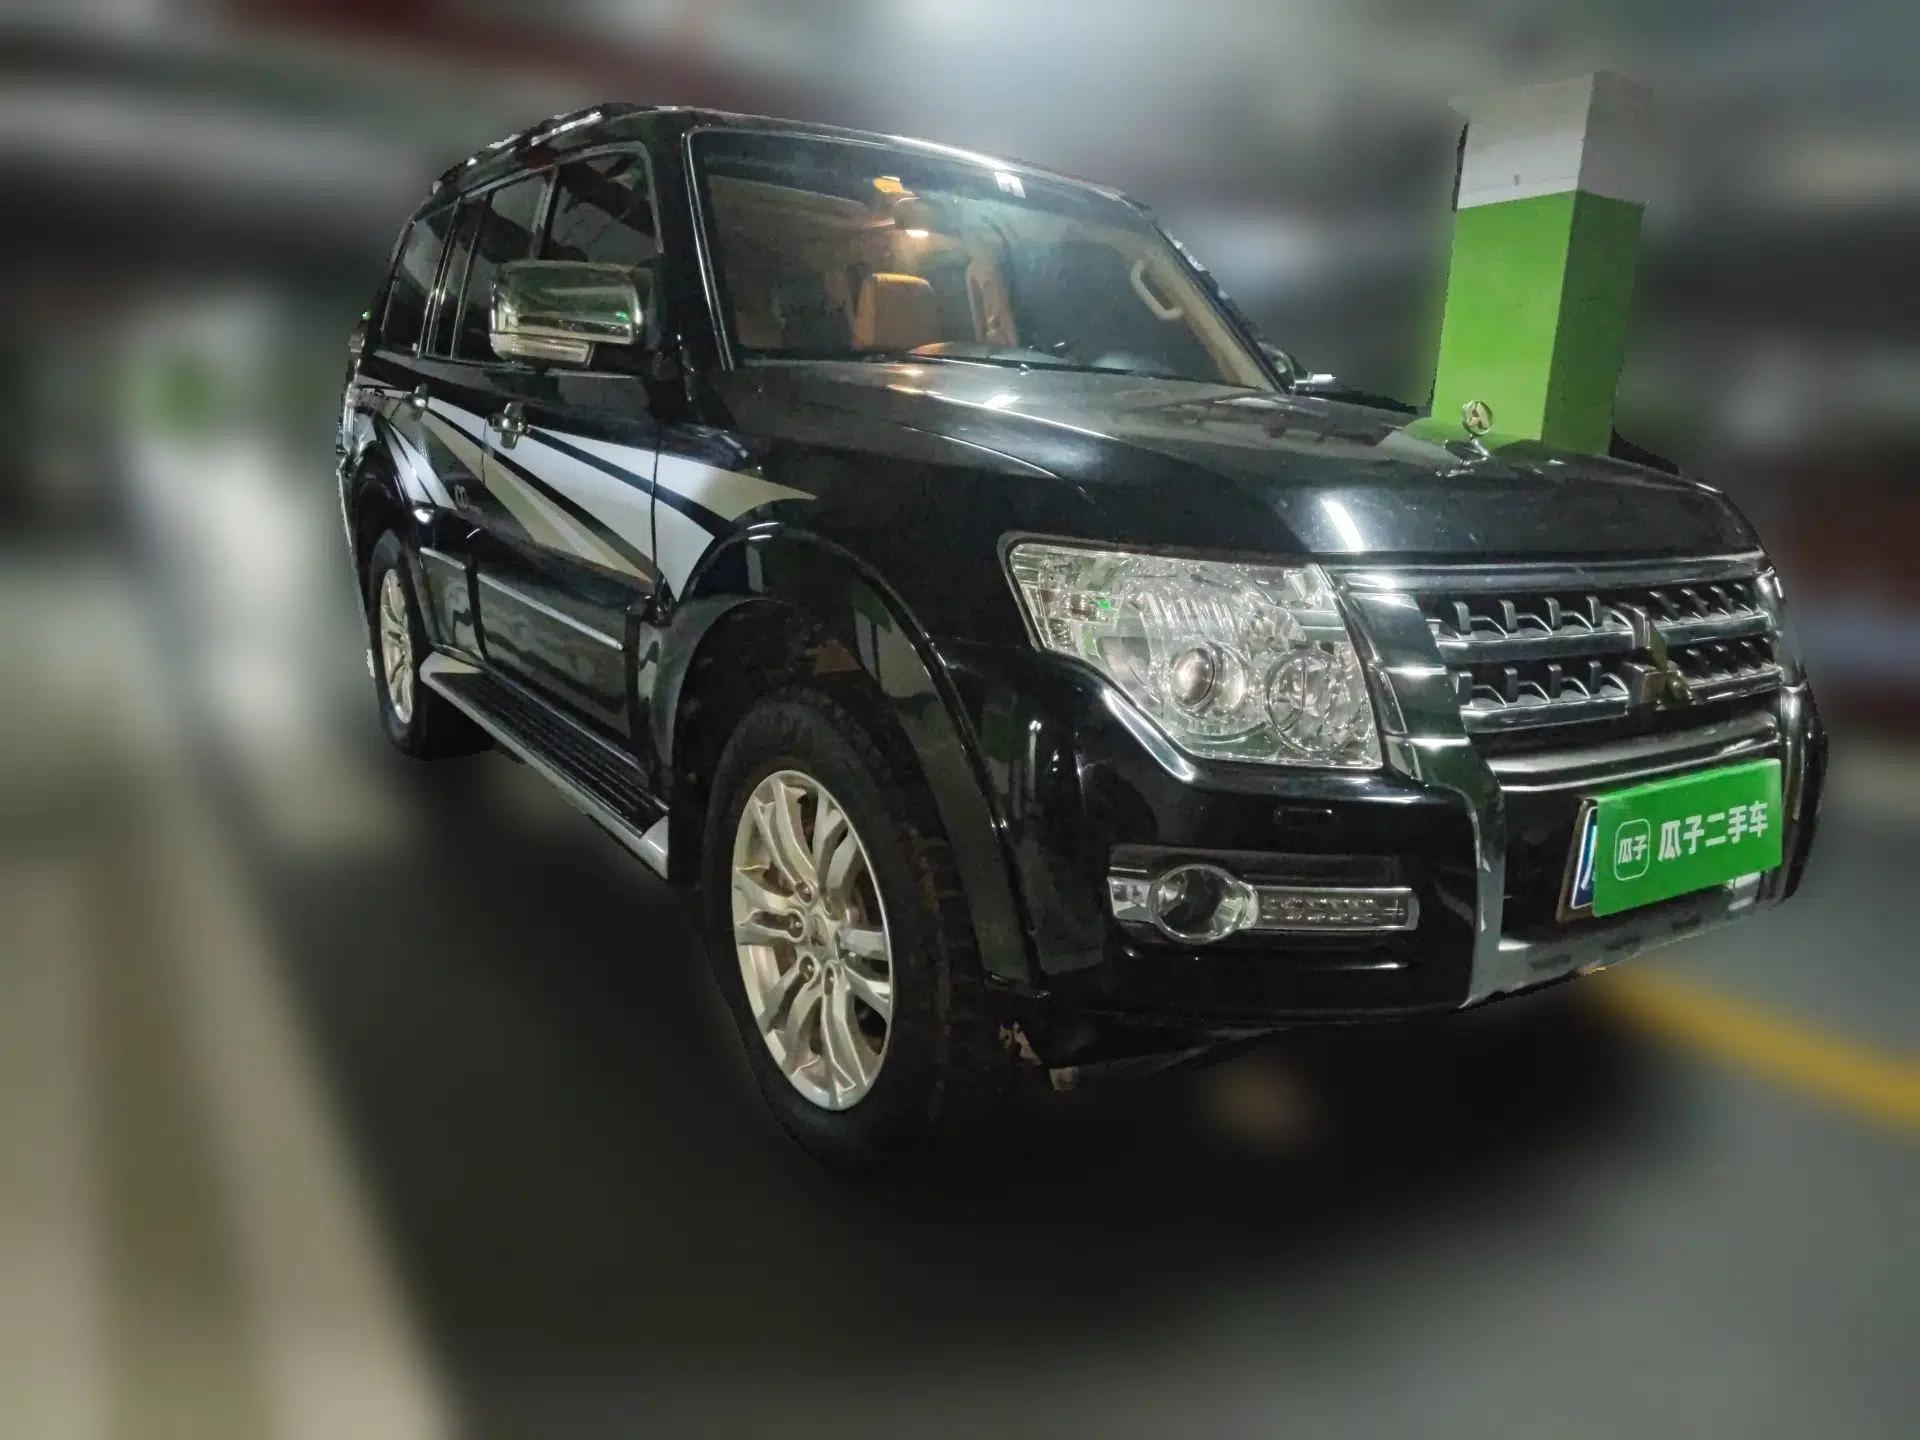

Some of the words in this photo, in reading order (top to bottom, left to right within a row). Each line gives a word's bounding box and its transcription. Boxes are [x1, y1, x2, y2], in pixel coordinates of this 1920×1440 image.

[1618, 834, 1647, 864] 瓜子
[1657, 800, 1768, 861] 瓜子二手车
